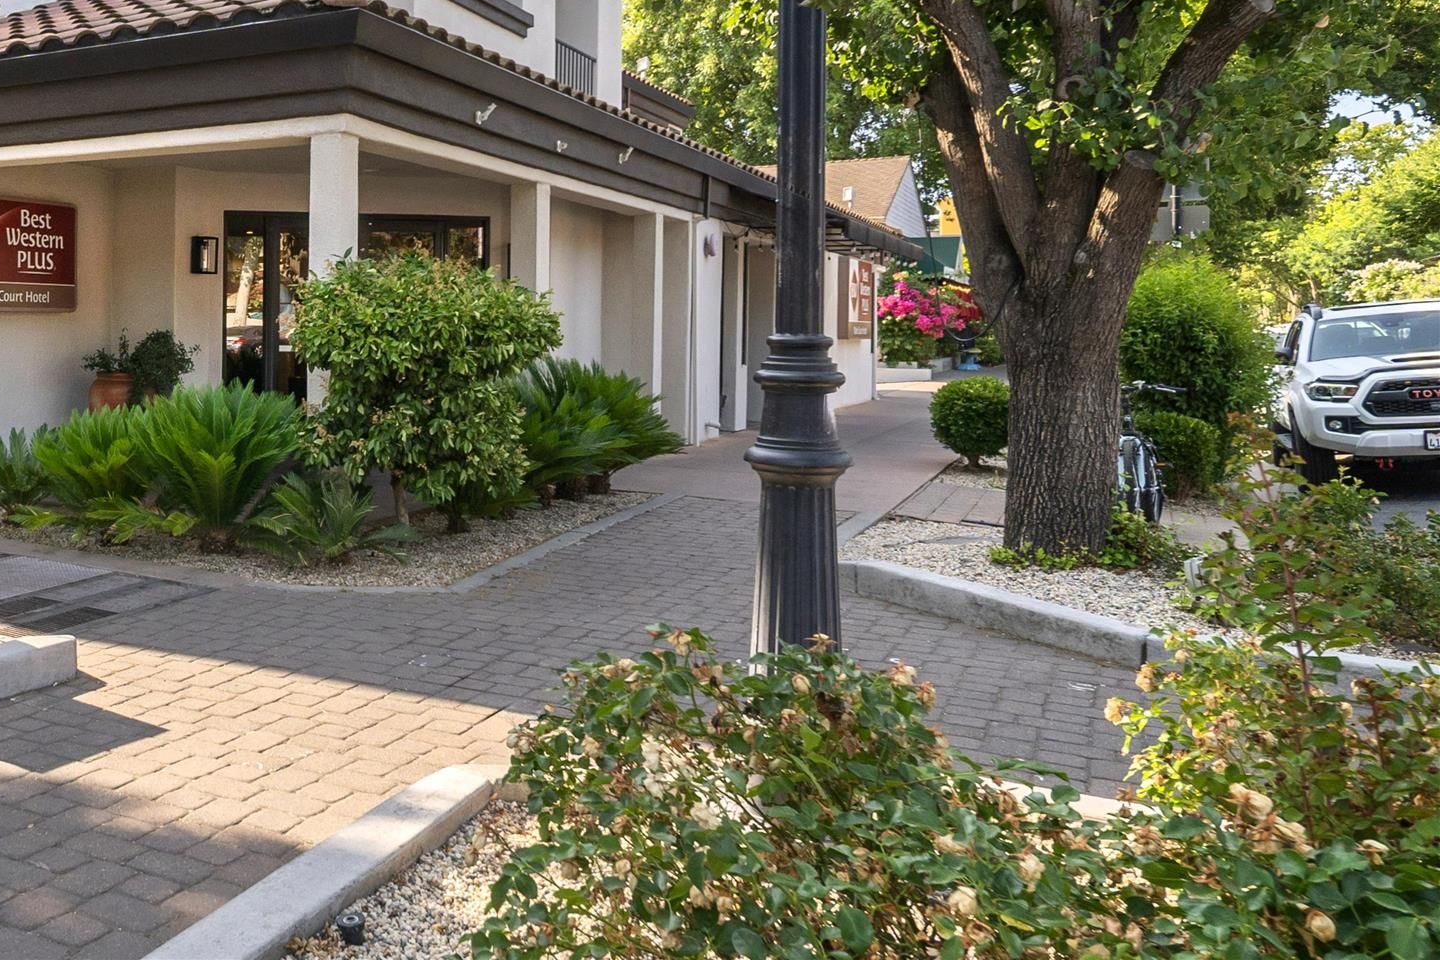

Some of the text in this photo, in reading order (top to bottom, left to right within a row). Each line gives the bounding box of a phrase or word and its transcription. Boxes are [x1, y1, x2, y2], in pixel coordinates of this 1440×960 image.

[20, 209, 52, 230] Best
[6, 227, 64, 250] Western
[17, 250, 54, 271] PLUS
[25, 291, 51, 304] Hotel
